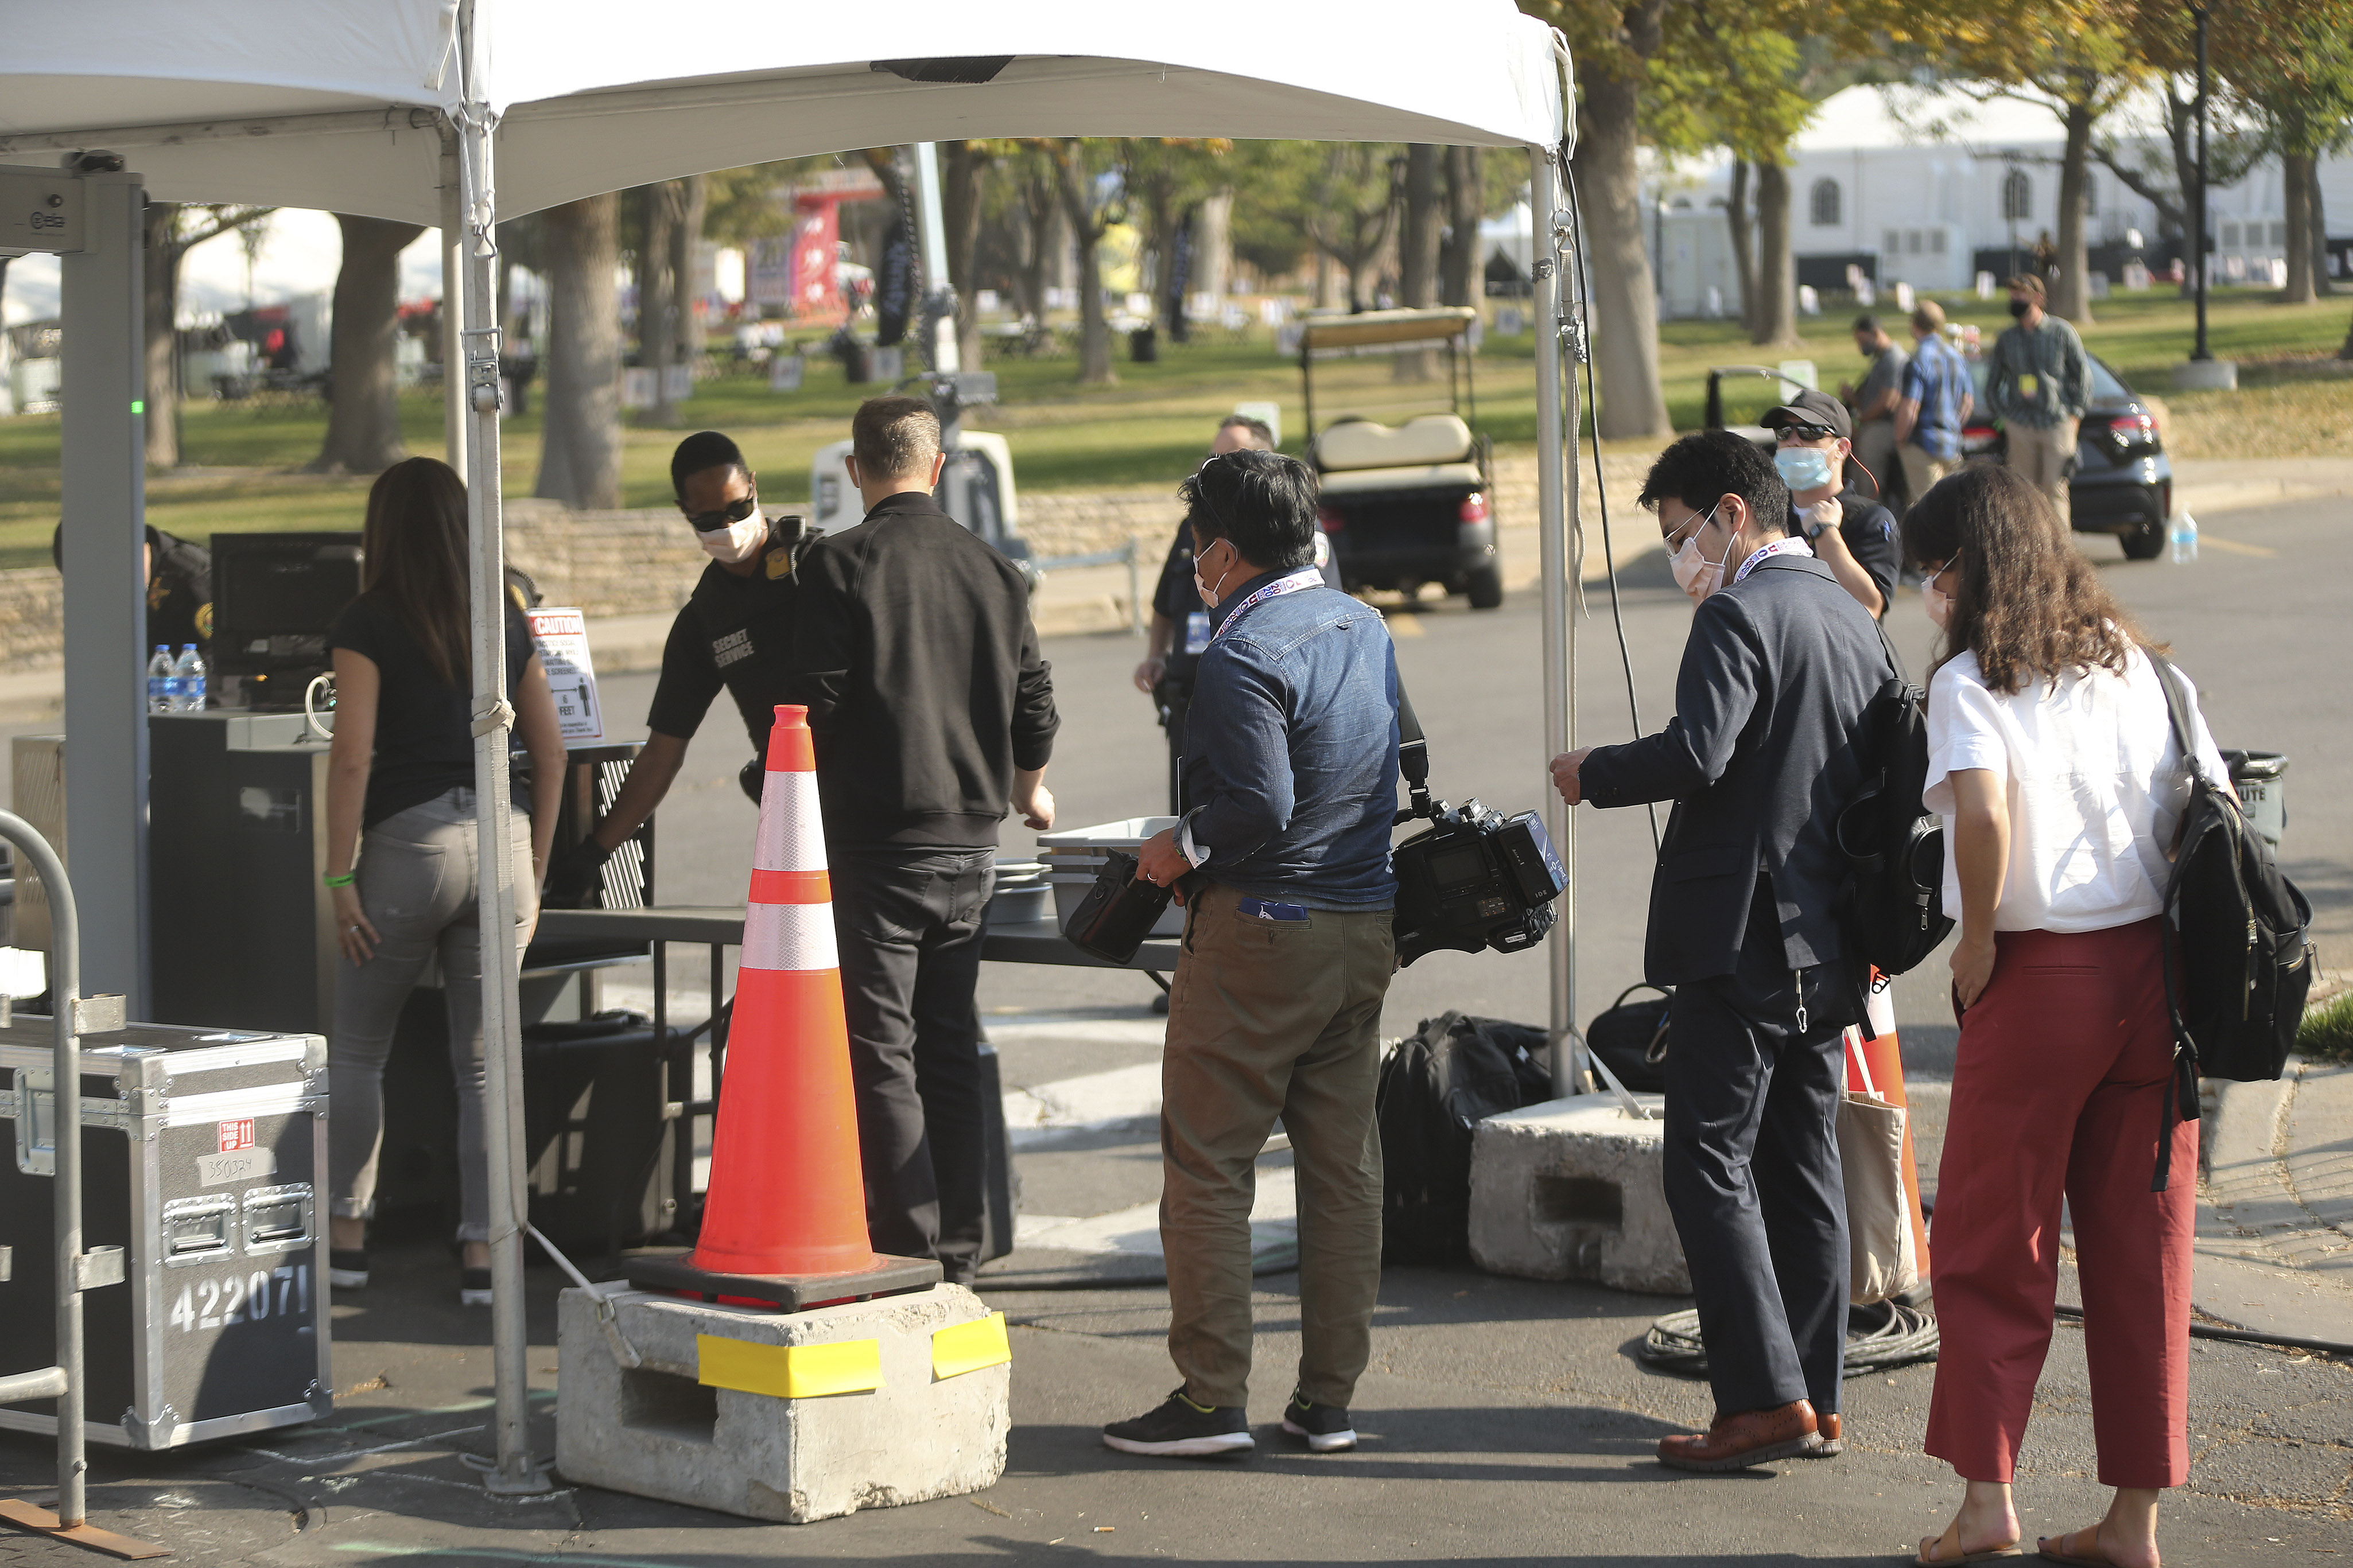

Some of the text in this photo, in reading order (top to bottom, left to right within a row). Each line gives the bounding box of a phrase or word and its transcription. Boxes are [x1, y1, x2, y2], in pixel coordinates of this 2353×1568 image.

[1263, 586, 1273, 597] 20
[1271, 583, 1281, 594] 20
[536, 617, 582, 635] CAUTION
[712, 628, 747, 653] SECRET
[715, 641, 754, 668] SERVICE
[559, 706, 575, 716] FEET
[2237, 785, 2266, 801] UTE
[222, 1122, 238, 1132] THIS
[222, 1130, 239, 1141] SIDE
[226, 1141, 237, 1150] UP
[170, 1264, 308, 1333] 422071
